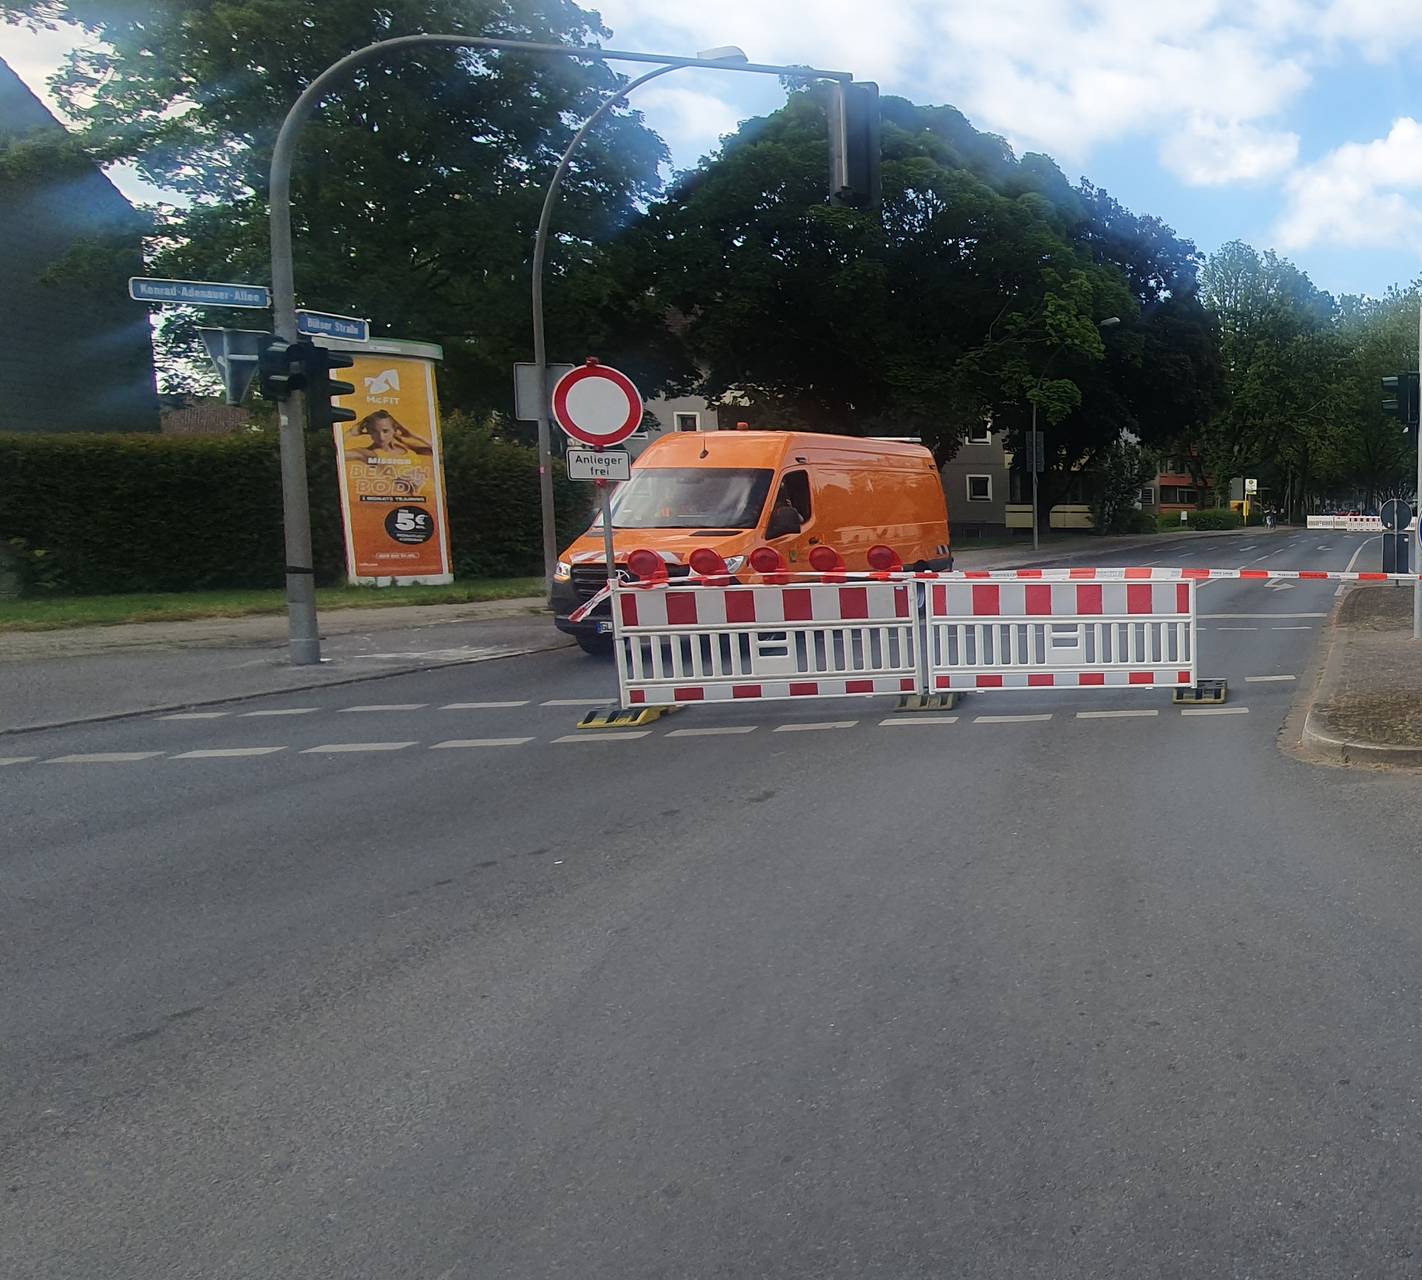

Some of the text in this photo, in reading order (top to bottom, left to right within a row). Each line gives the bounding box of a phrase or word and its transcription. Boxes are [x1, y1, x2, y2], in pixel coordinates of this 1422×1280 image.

[139, 283, 260, 302] Konrad-Adenauer-Allee
[575, 455, 622, 467] Anlieger
[350, 464, 431, 481] BEACH
[590, 466, 609, 476] frei
[356, 478, 426, 496] BODY
